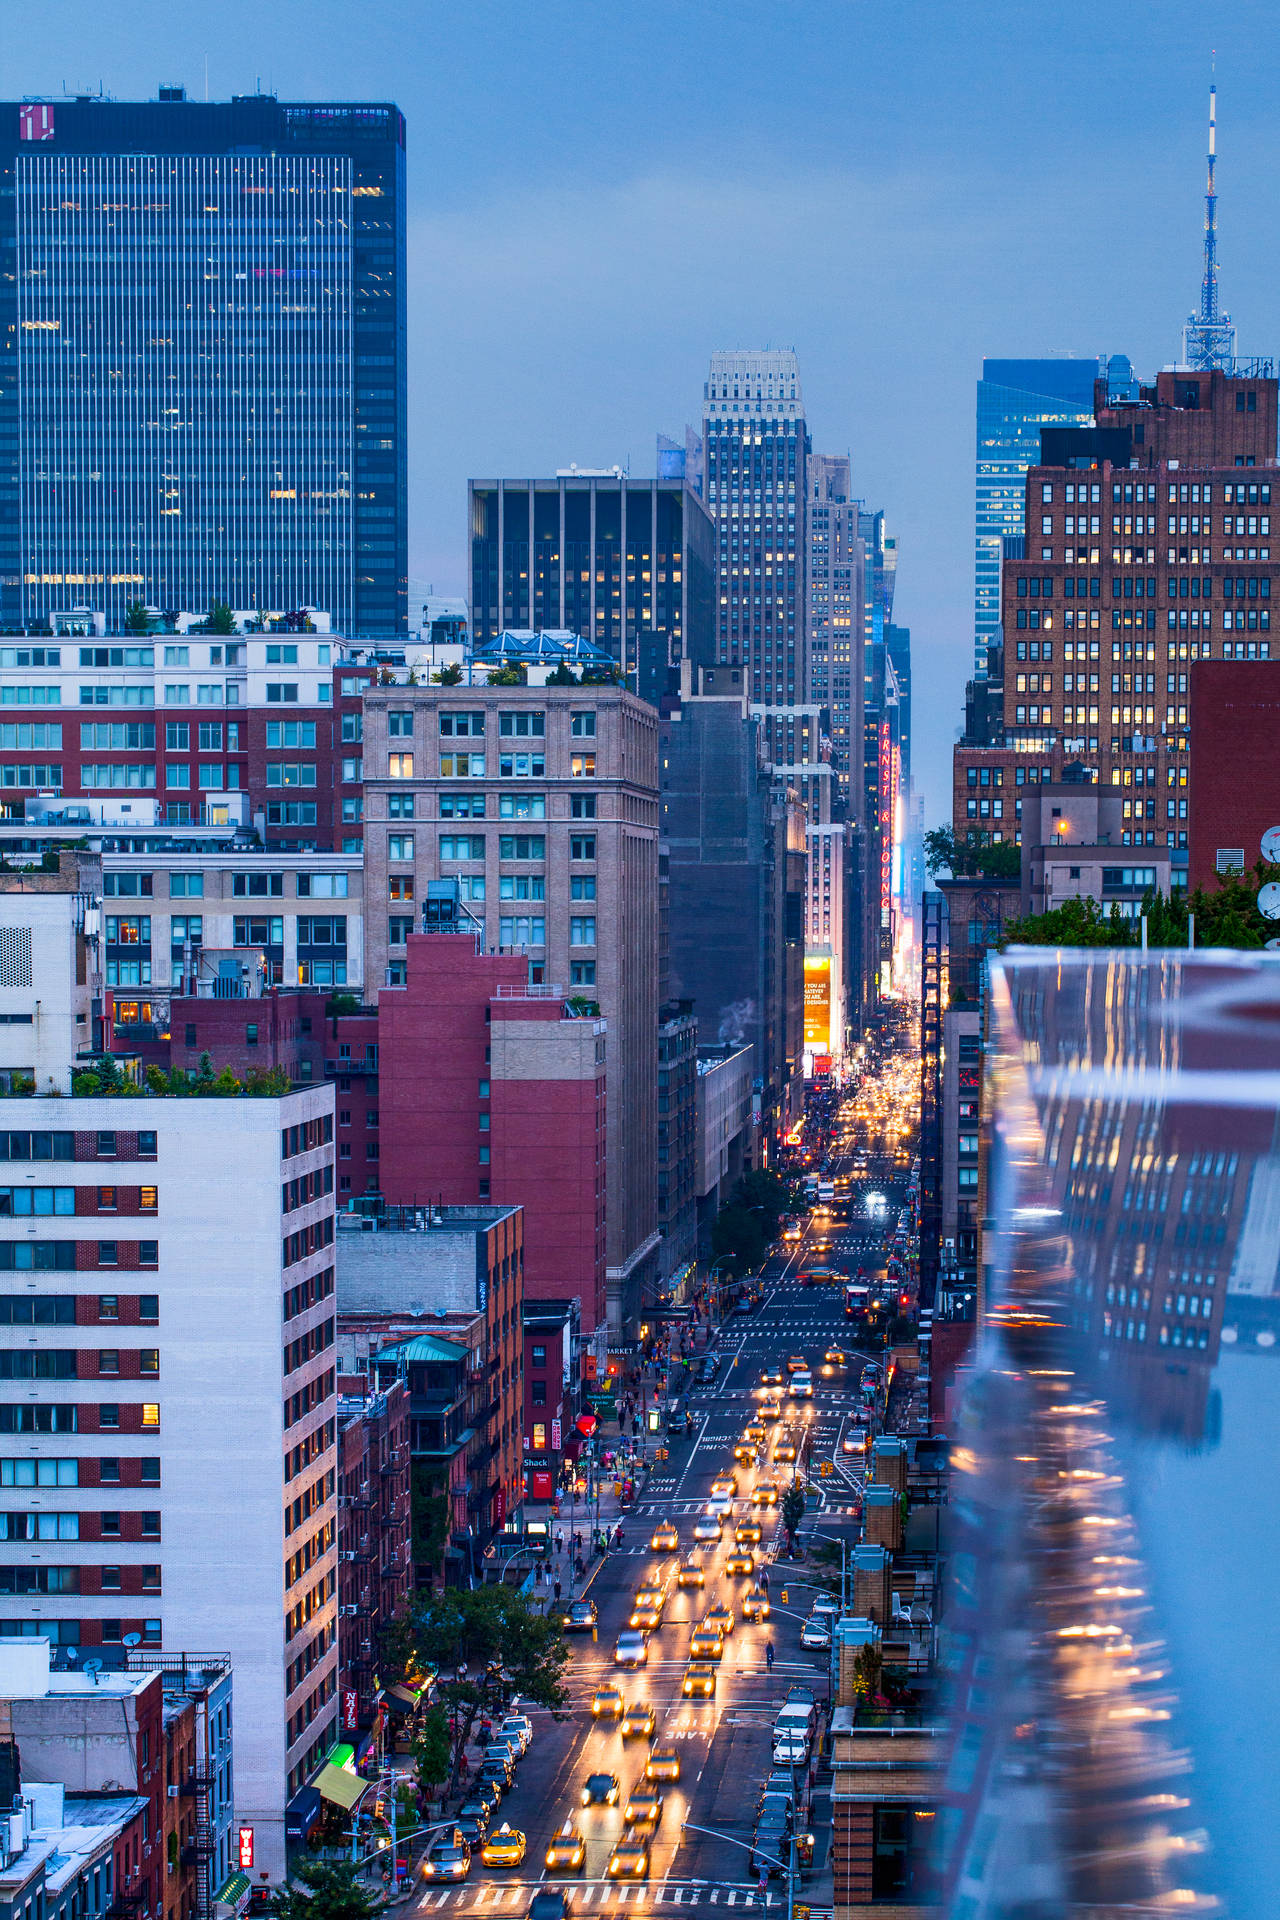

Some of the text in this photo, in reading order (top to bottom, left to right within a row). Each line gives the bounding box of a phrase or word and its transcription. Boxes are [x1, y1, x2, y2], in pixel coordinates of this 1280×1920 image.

[881, 723, 890, 908] ERNST & YOUNG
[524, 1458, 548, 1467] Shack
[346, 1692, 356, 1728] NAILS
[668, 1718, 711, 1727] FIRE
[664, 1731, 708, 1740] LANE
[240, 1830, 252, 1866] WINE
